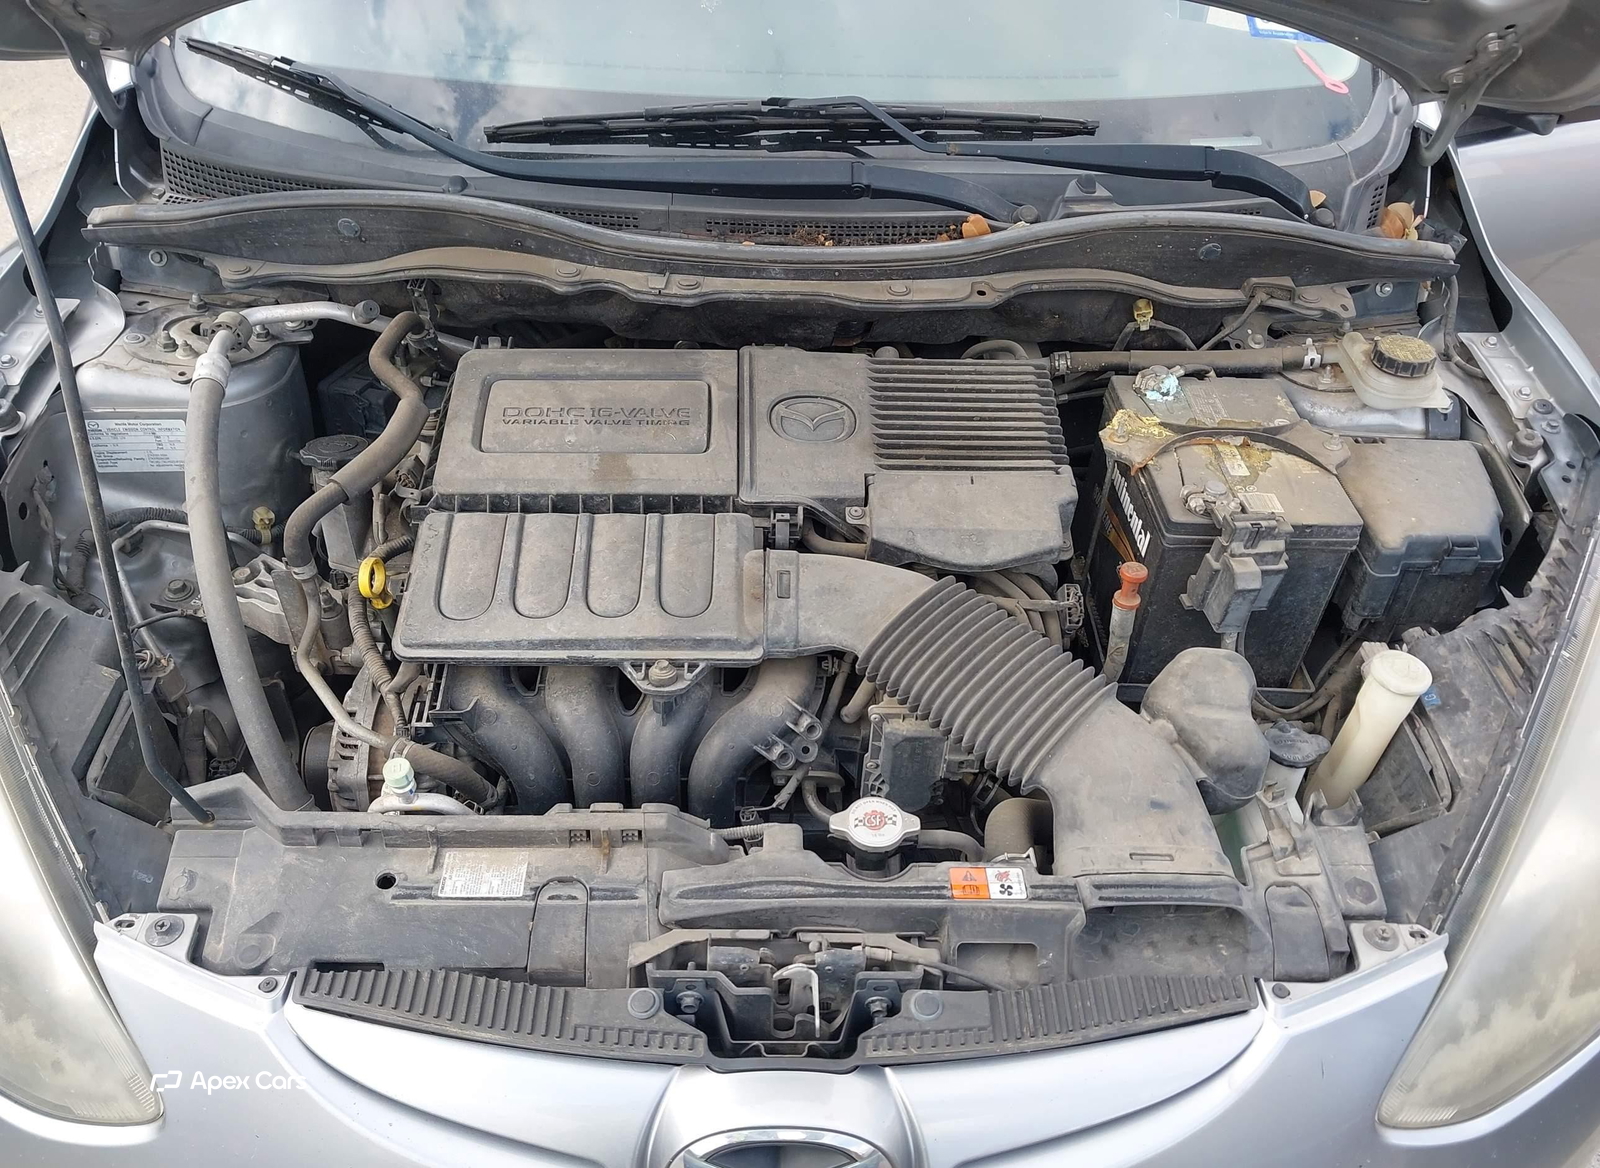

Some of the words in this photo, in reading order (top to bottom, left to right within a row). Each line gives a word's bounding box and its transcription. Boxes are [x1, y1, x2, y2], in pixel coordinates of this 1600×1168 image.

[502, 406, 586, 418] DOHC
[591, 406, 691, 418] 16-VALVE
[502, 418, 579, 426] VARIABLE
[583, 418, 632, 426] VALVE
[864, 814, 882, 827] CSF
